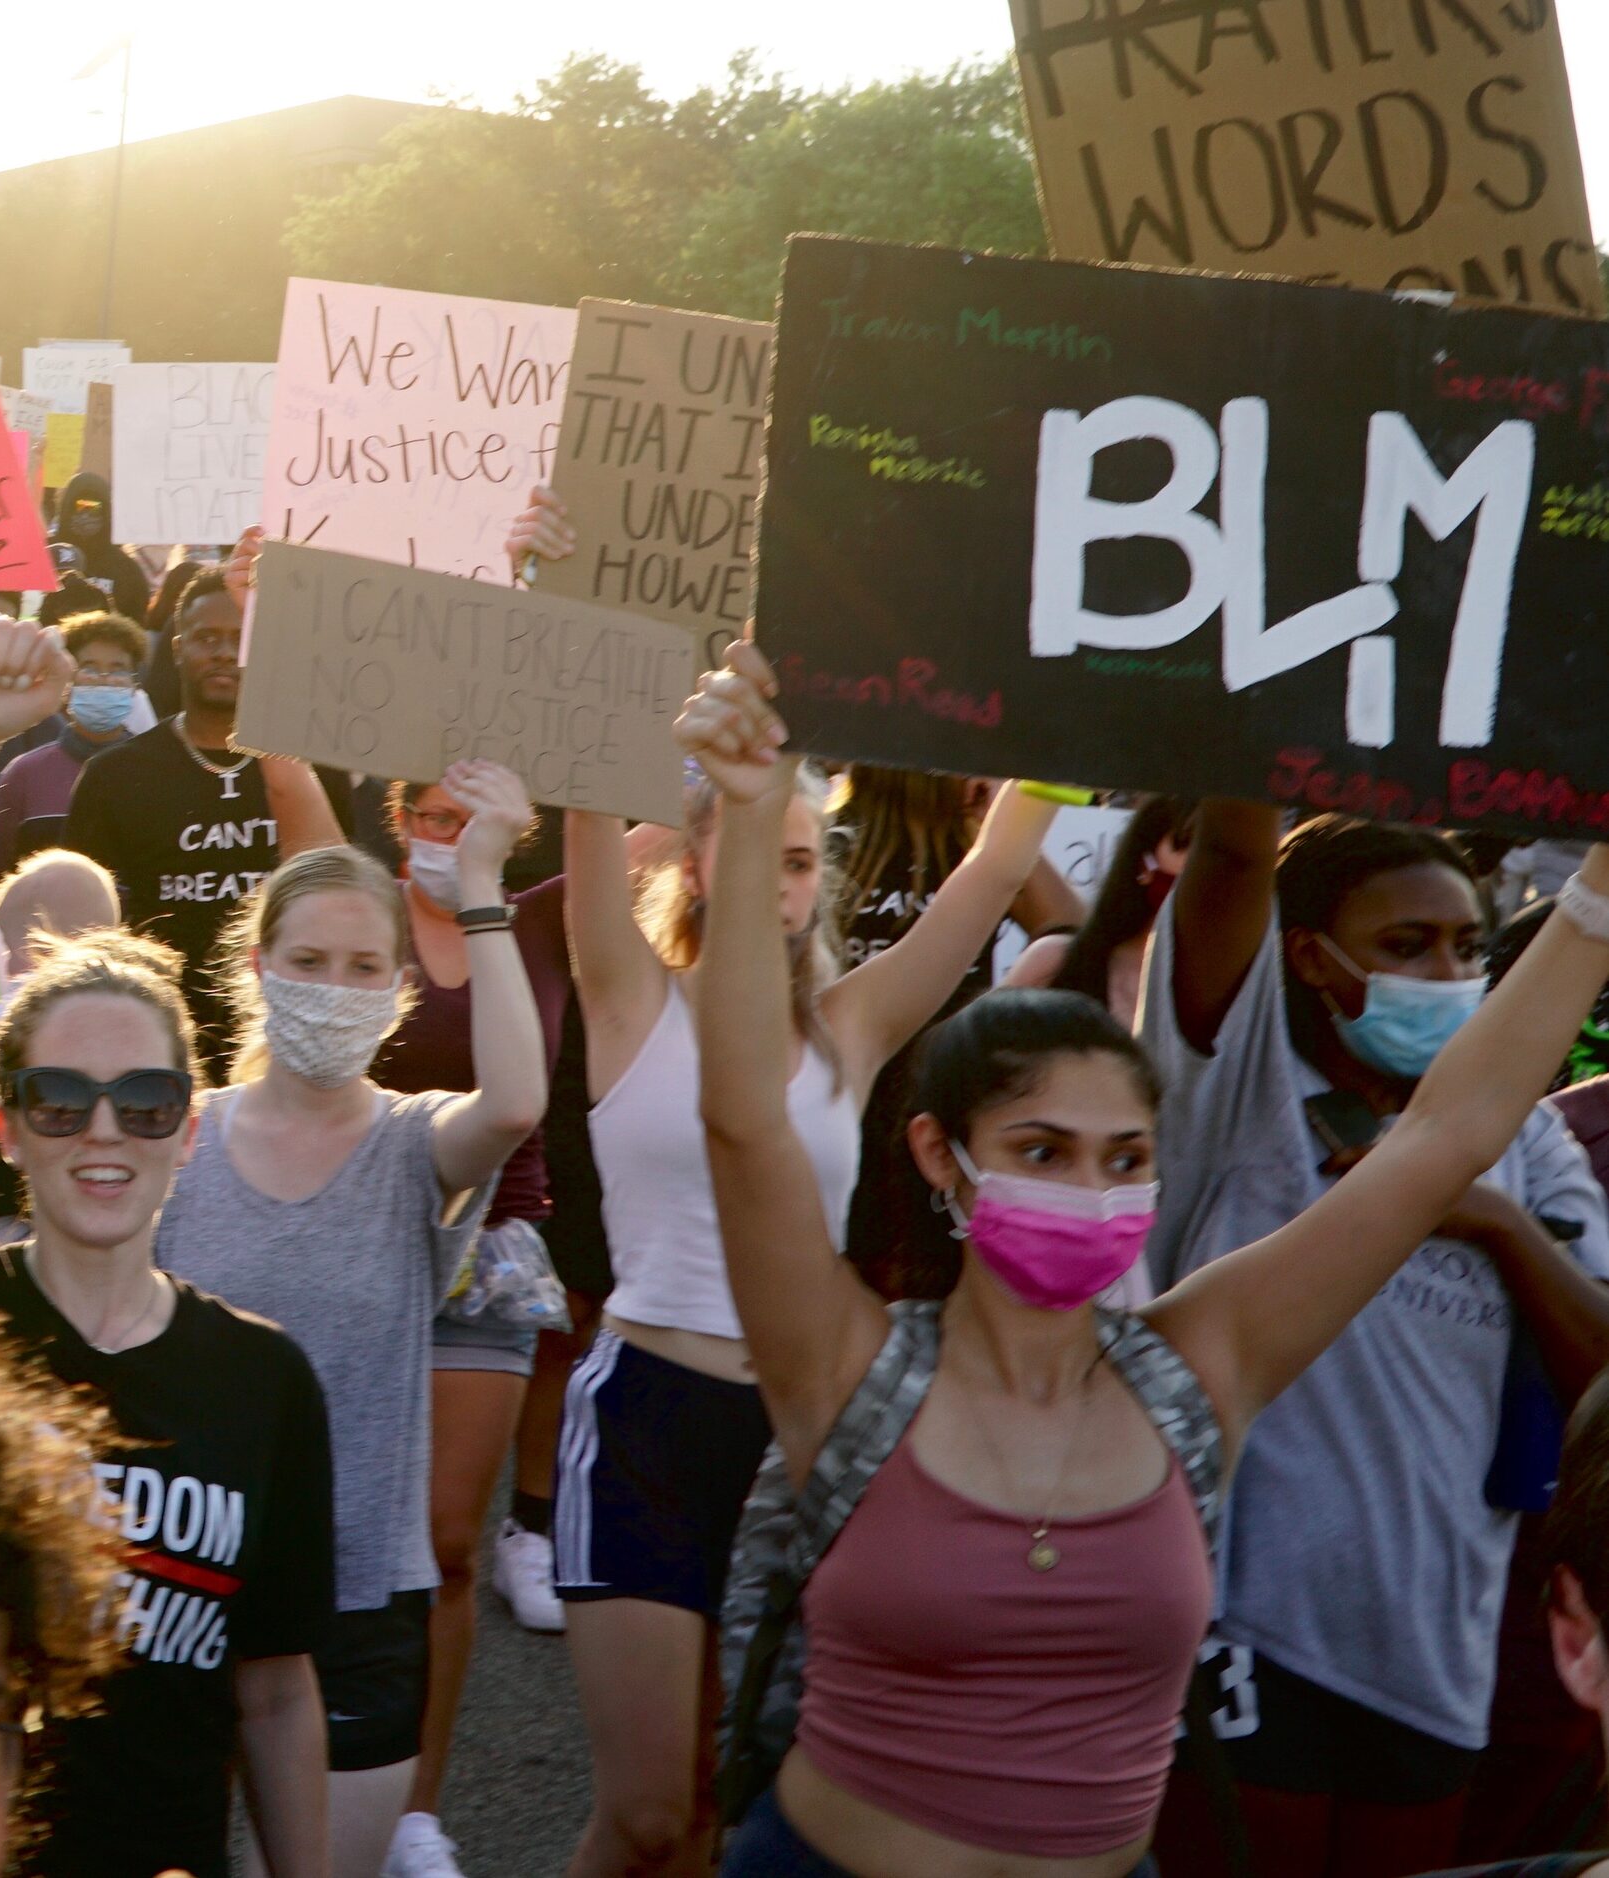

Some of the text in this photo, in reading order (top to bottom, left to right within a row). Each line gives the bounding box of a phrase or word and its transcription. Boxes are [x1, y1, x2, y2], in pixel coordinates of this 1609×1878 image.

[1079, 75, 1549, 266] WORDS
[318, 293, 421, 391] We
[586, 316, 771, 408] I UN
[955, 306, 1117, 363] Martin
[167, 364, 277, 430] BLAC
[573, 390, 713, 474] THAT
[163, 431, 269, 482] LIVE
[285, 407, 515, 487] Justice
[155, 485, 264, 539] MAT
[622, 480, 755, 560] UNDE
[591, 544, 748, 622] HOWE
[1028, 395, 1537, 749] BLM
[304, 706, 383, 758] NO
[310, 653, 622, 766] NO JUSTICE
[217, 771, 242, 800] I
[158, 870, 273, 902] BREAT
[86, 1461, 246, 1567] EDOM
[97, 1571, 229, 1671] HING
